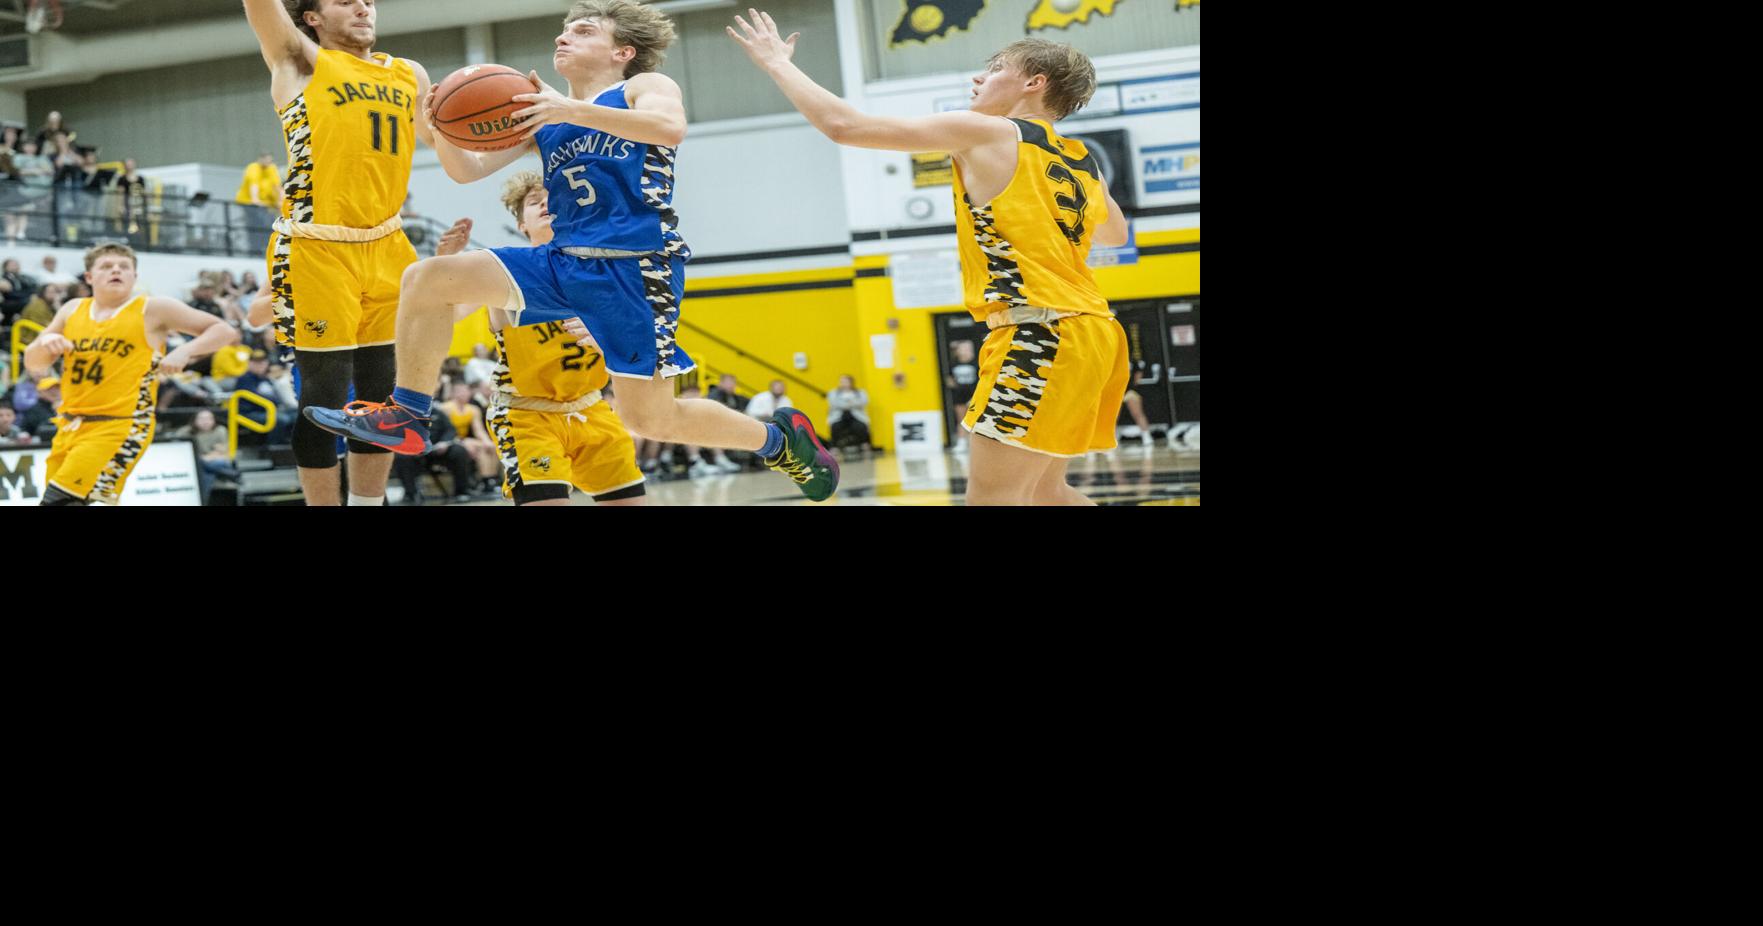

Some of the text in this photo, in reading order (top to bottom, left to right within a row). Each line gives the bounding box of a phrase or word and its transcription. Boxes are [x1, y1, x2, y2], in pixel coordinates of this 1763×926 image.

[368, 111, 399, 155] 11
[561, 165, 597, 207] 5
[1046, 161, 1088, 245] 3
[69, 337, 135, 358] ACKETS
[71, 356, 104, 385] 54
[0, 454, 38, 499] M
